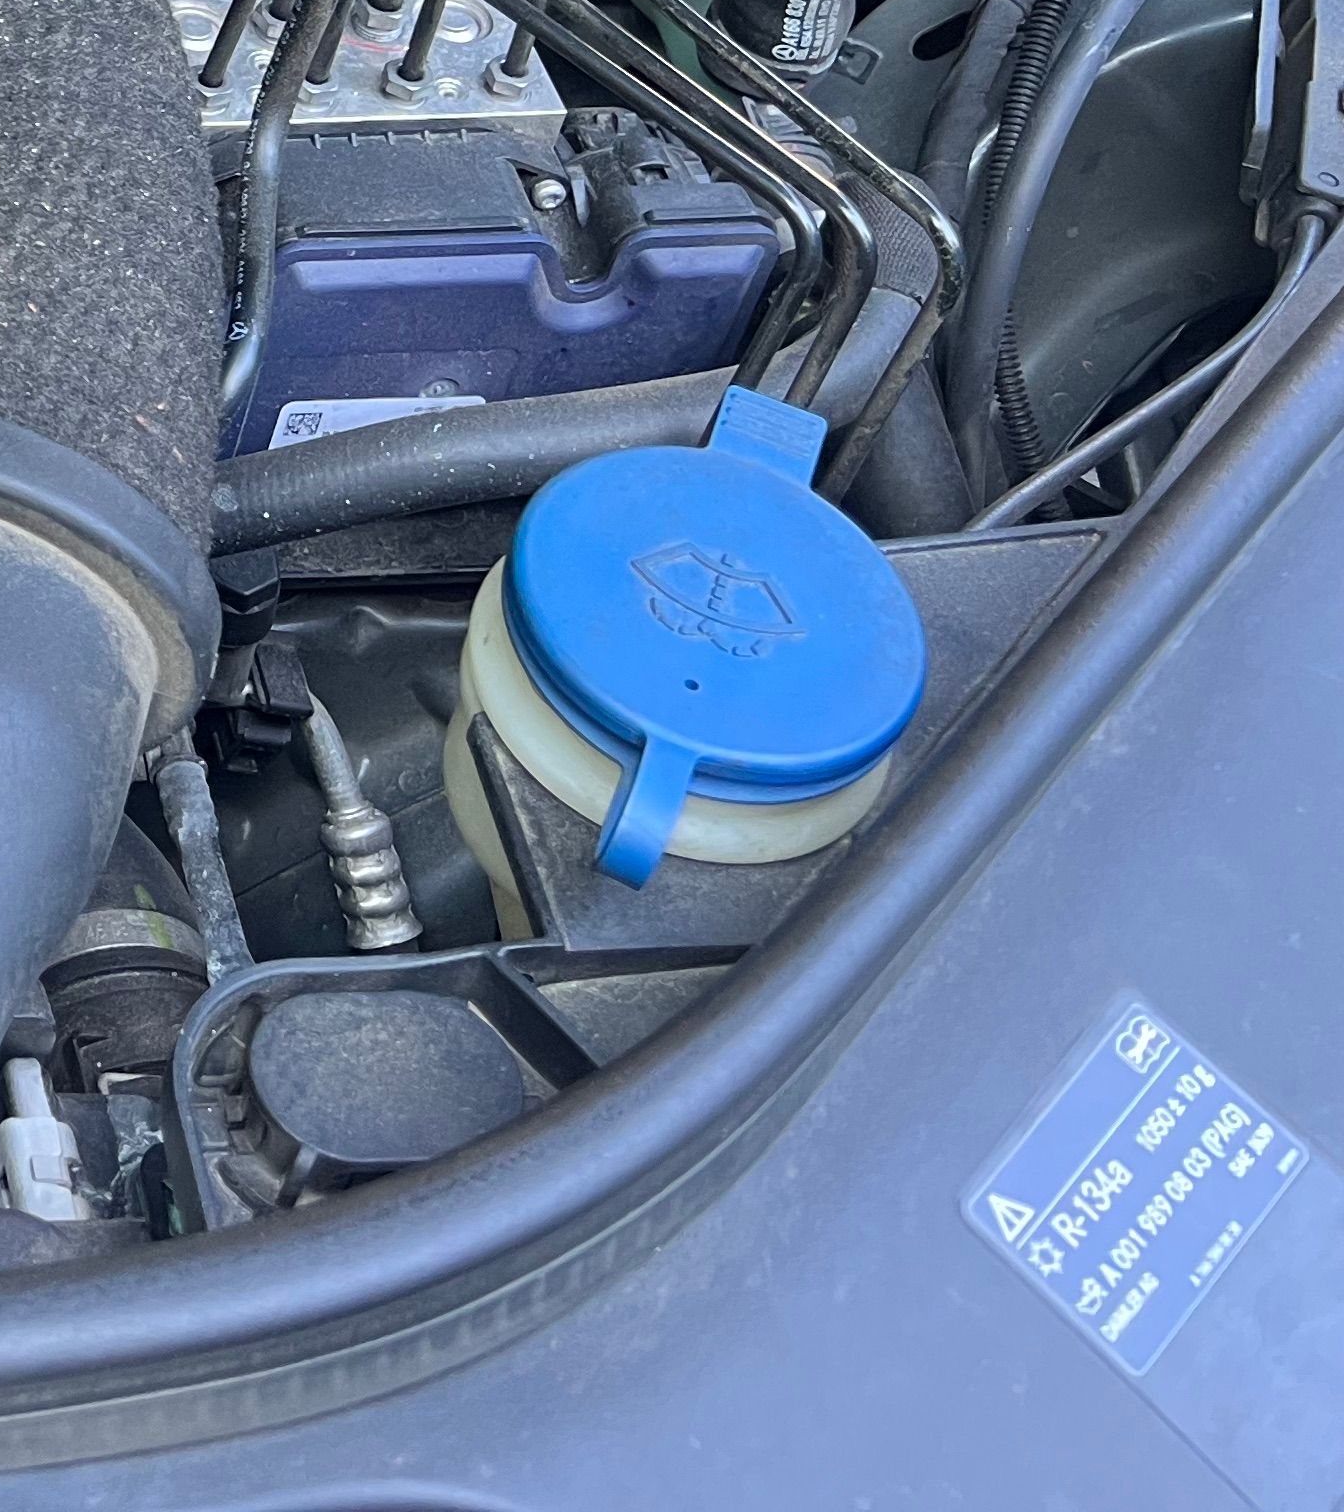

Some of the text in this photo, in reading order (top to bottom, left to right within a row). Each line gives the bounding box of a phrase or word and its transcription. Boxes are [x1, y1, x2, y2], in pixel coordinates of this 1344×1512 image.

[1201, 1101, 1253, 1159] (PAG)
[1049, 1158, 1134, 1247] R-134a
[1135, 1106, 1175, 1152] 1050
[1175, 1075, 1201, 1102] 10
[1183, 1149, 1213, 1179] 03
[1227, 1148, 1255, 1178] SAE
[1137, 1194, 1174, 1236] 989
[1110, 1229, 1149, 1271] 001
[1100, 1263, 1123, 1288] A
